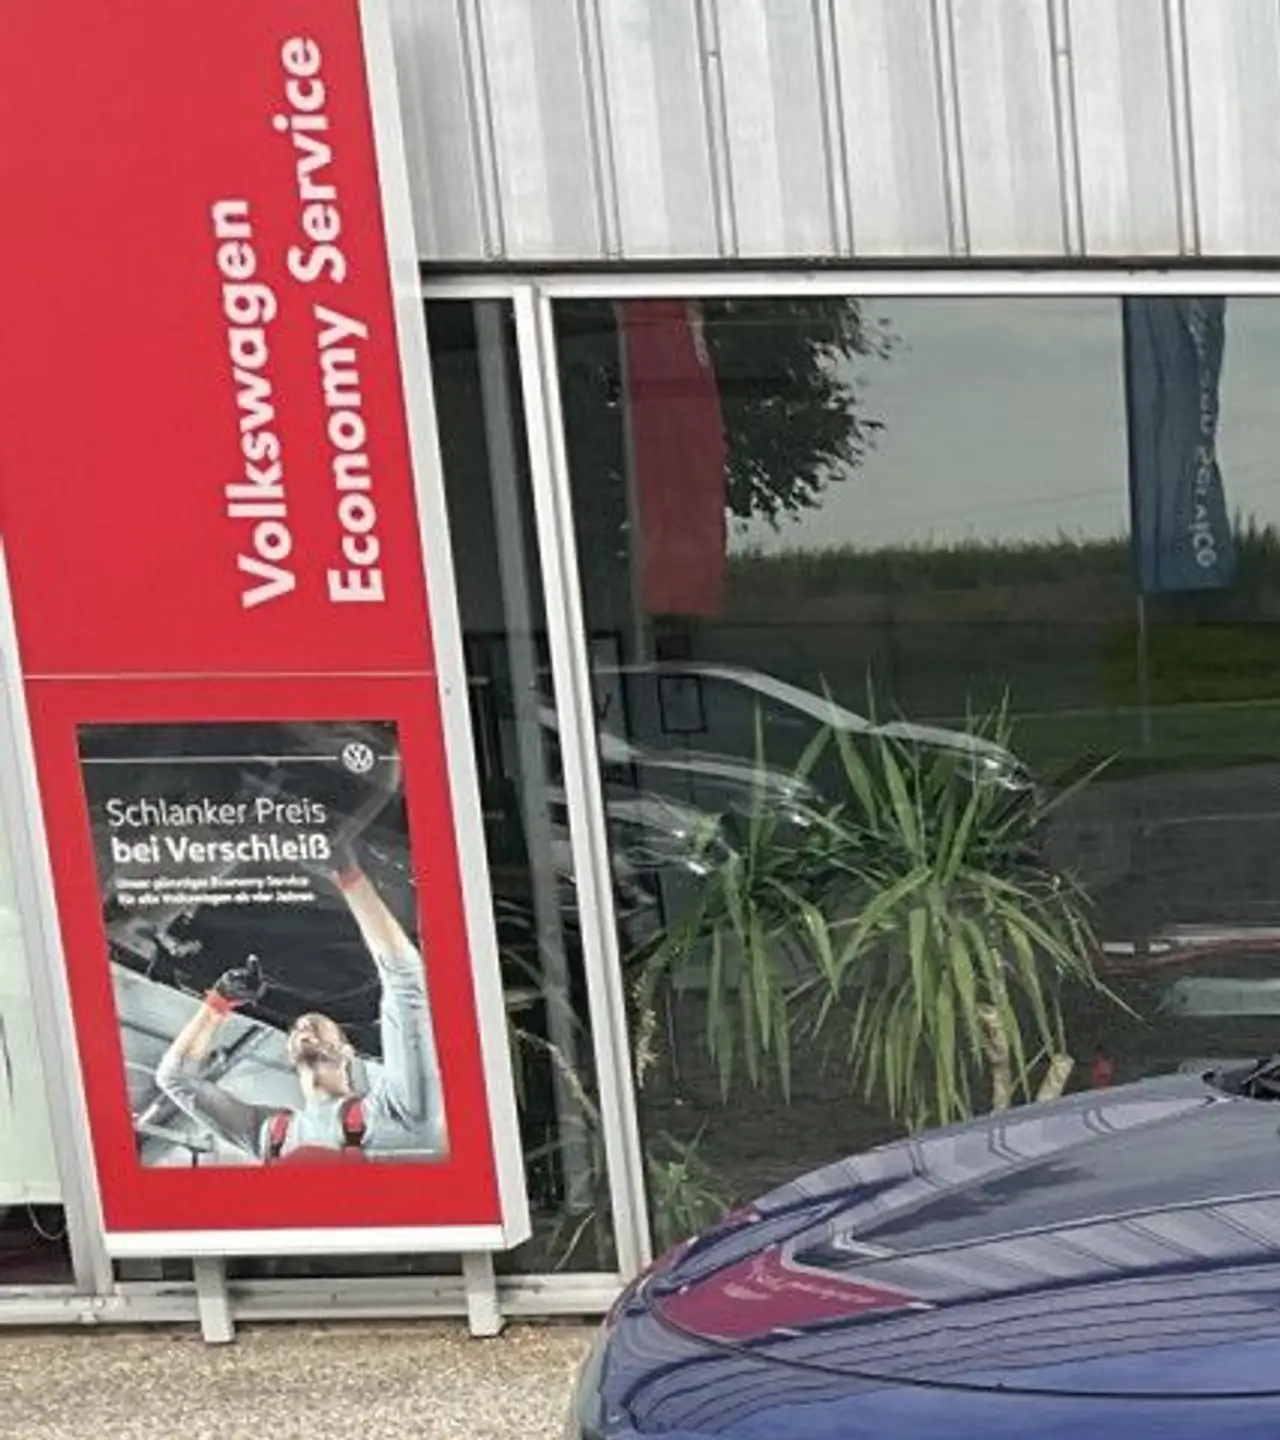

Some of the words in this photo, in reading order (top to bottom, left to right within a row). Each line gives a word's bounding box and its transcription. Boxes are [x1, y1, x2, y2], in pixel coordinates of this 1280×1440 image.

[272, 35, 347, 284] Service
[211, 198, 297, 609] Volkswagen
[313, 303, 386, 604] Economy
[105, 797, 248, 828] Schlanker
[255, 797, 328, 824] Preis
[110, 835, 161, 864] bei
[164, 832, 332, 864] Verschleiß
